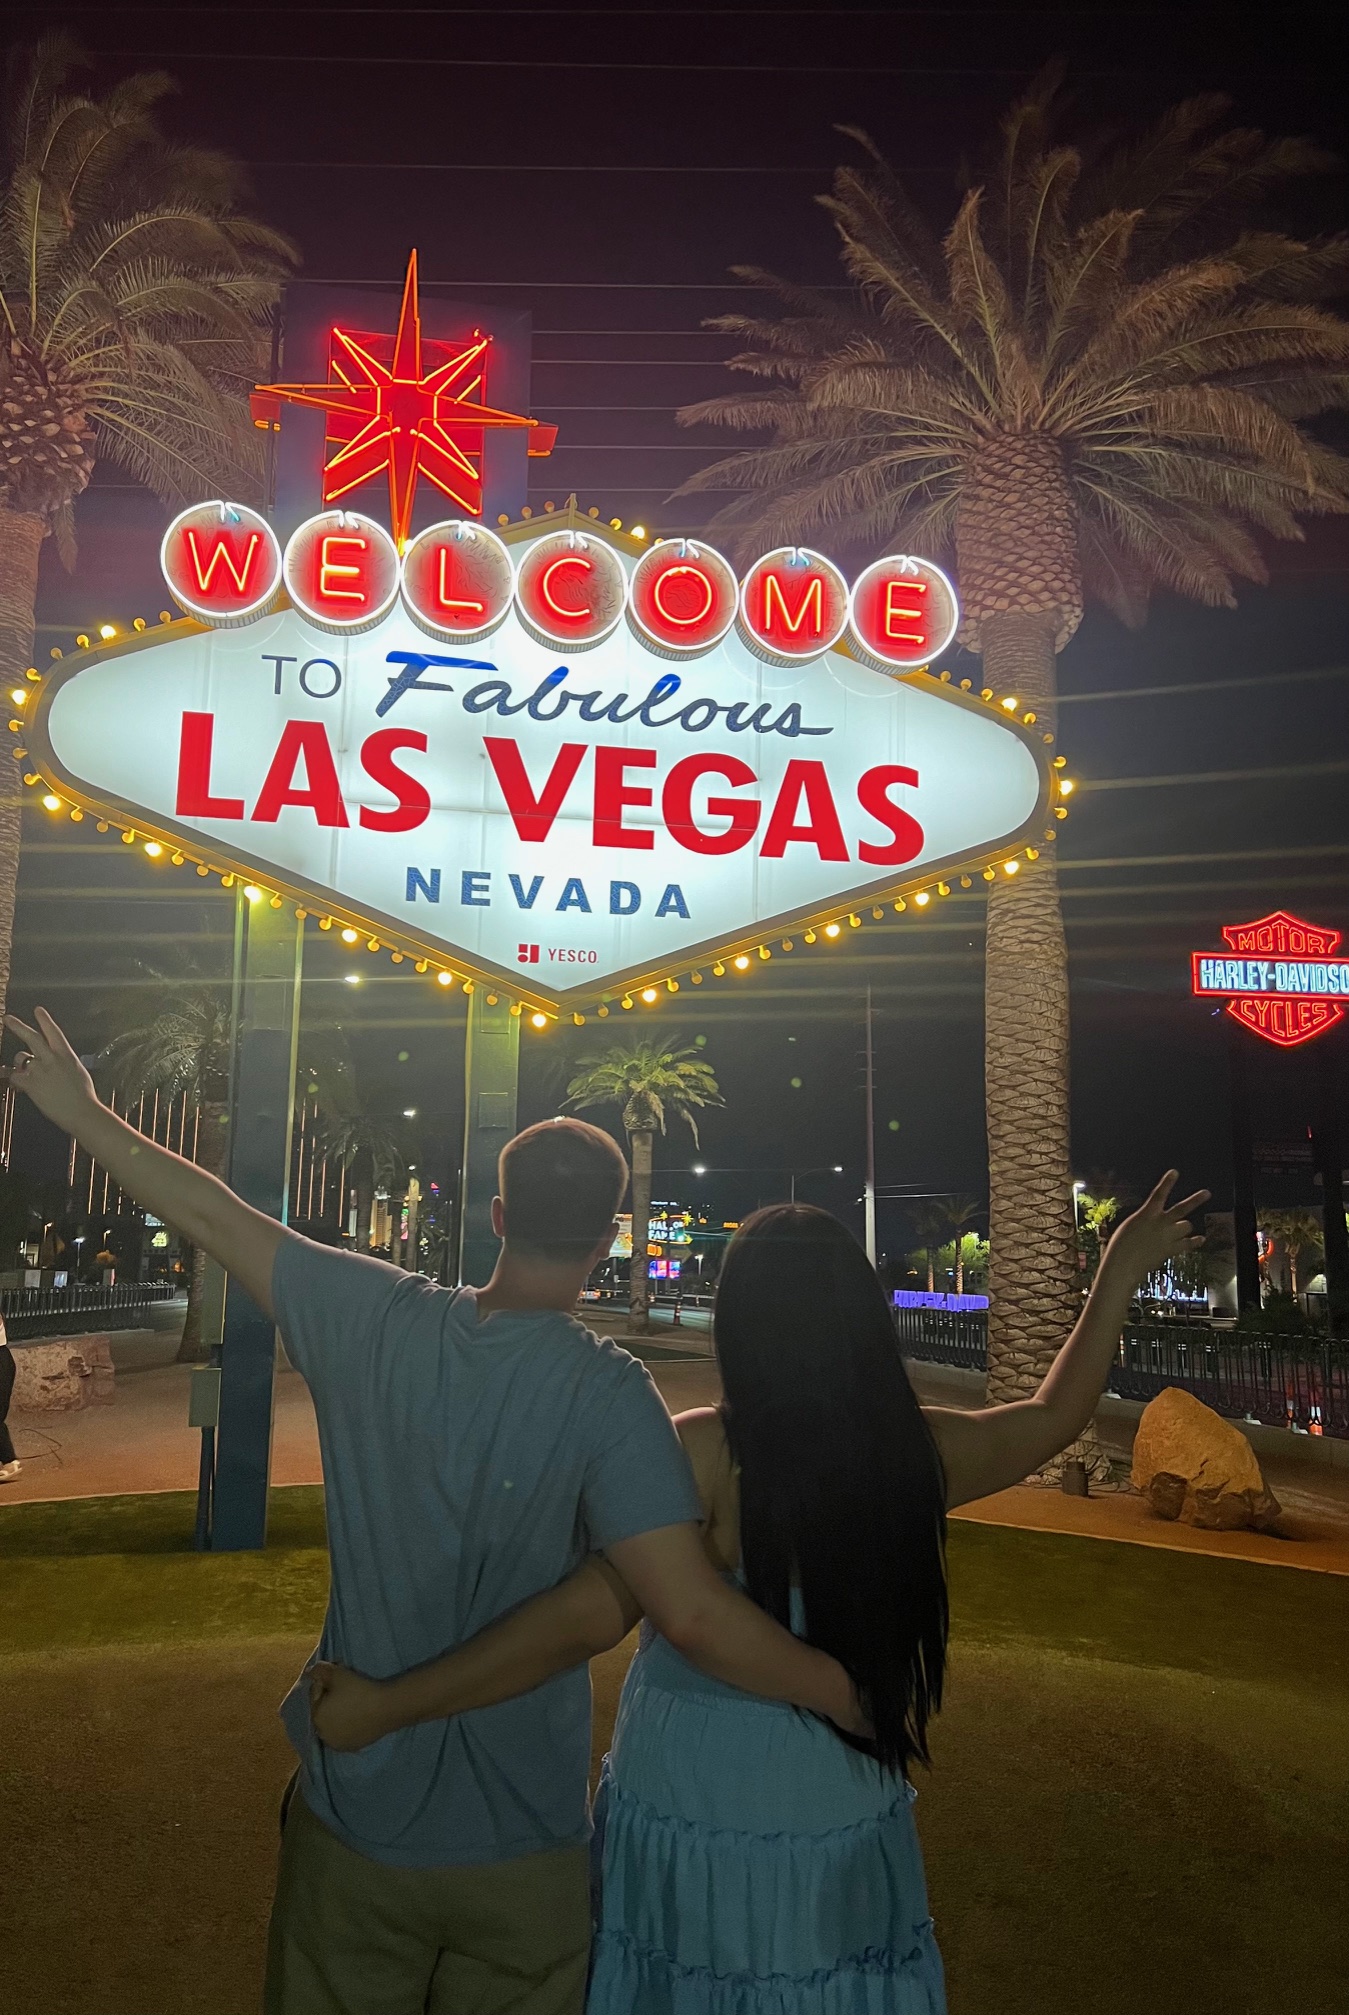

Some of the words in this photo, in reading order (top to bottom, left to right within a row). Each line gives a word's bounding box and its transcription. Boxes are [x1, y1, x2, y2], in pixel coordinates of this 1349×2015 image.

[183, 529, 928, 648] WELCOME
[262, 654, 342, 699] TO
[374, 650, 834, 738] Fabulous
[175, 711, 431, 834] LAS
[482, 735, 925, 866] VEGAS
[404, 866, 692, 920] NEVADA
[548, 948, 597, 964] YESCO
[1238, 920, 1325, 953] MOTOR
[1241, 1000, 1326, 1037] CYCLES
